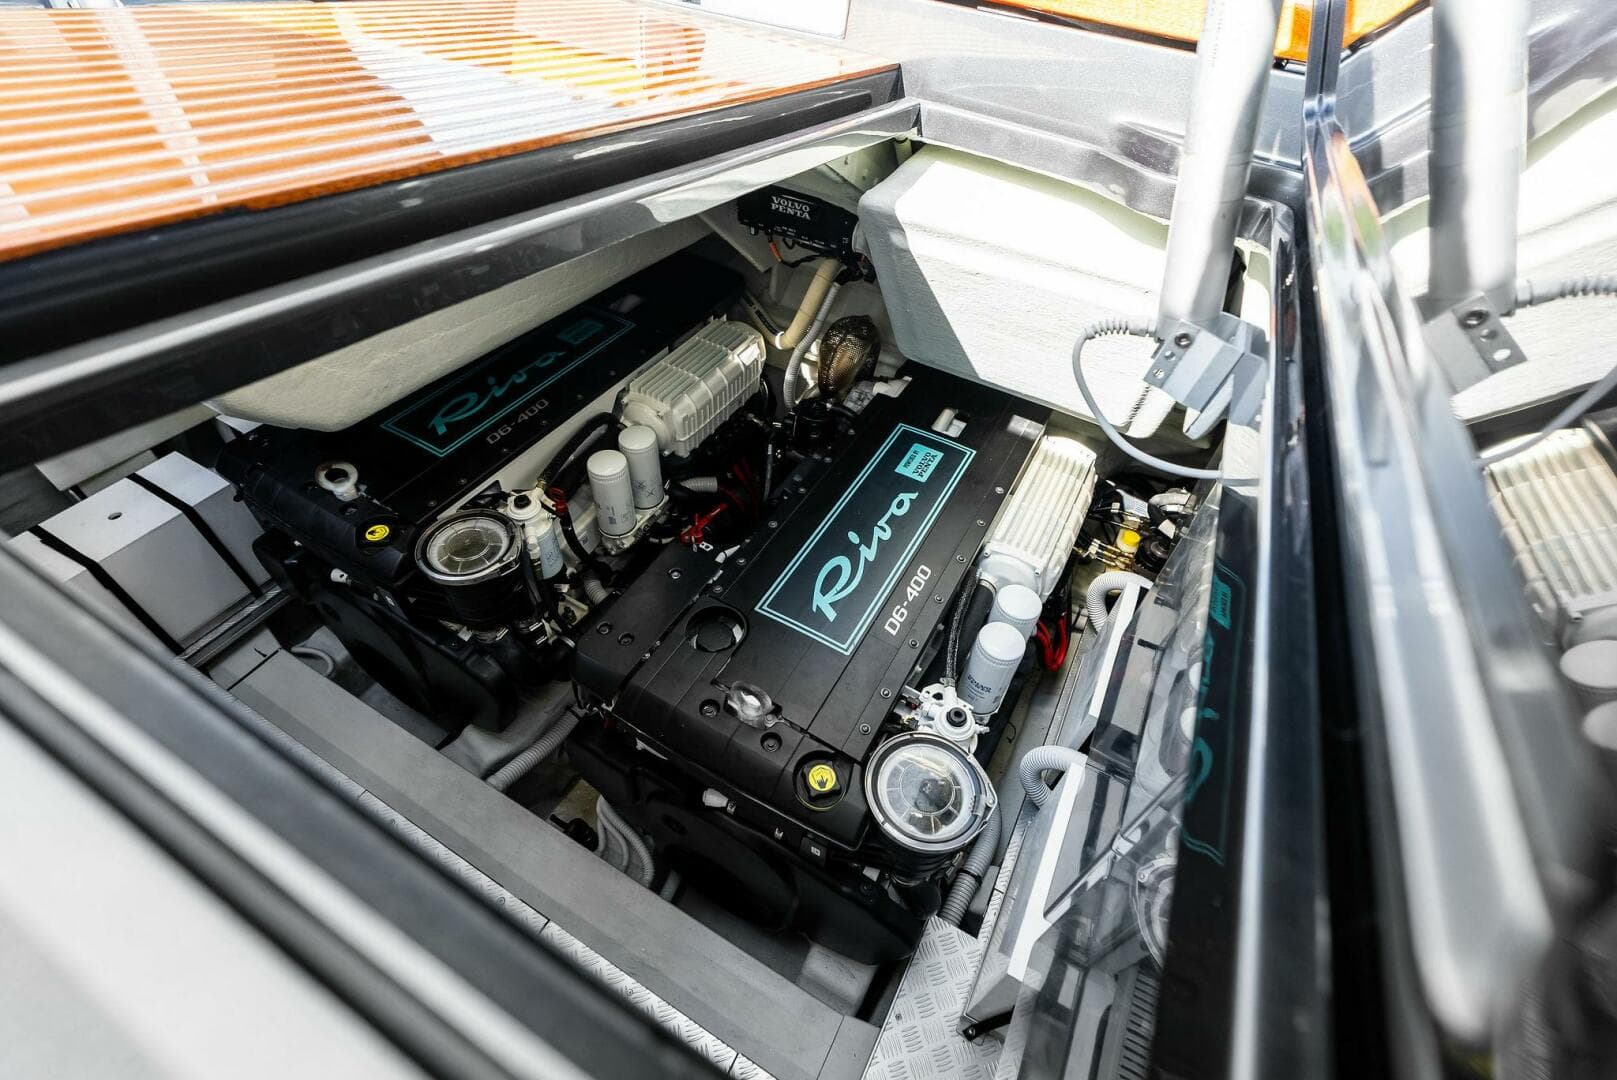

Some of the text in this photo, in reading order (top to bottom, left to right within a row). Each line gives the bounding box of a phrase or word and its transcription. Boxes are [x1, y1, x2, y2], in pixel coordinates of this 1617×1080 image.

[771, 196, 810, 212] VOLVO
[771, 203, 811, 220] PENTA
[428, 351, 567, 436] Riva
[486, 399, 550, 445] D6-400
[912, 452, 931, 474] VOLVO
[918, 454, 938, 478] PENTA
[812, 491, 919, 622] Riva
[884, 565, 932, 636] D6-400
